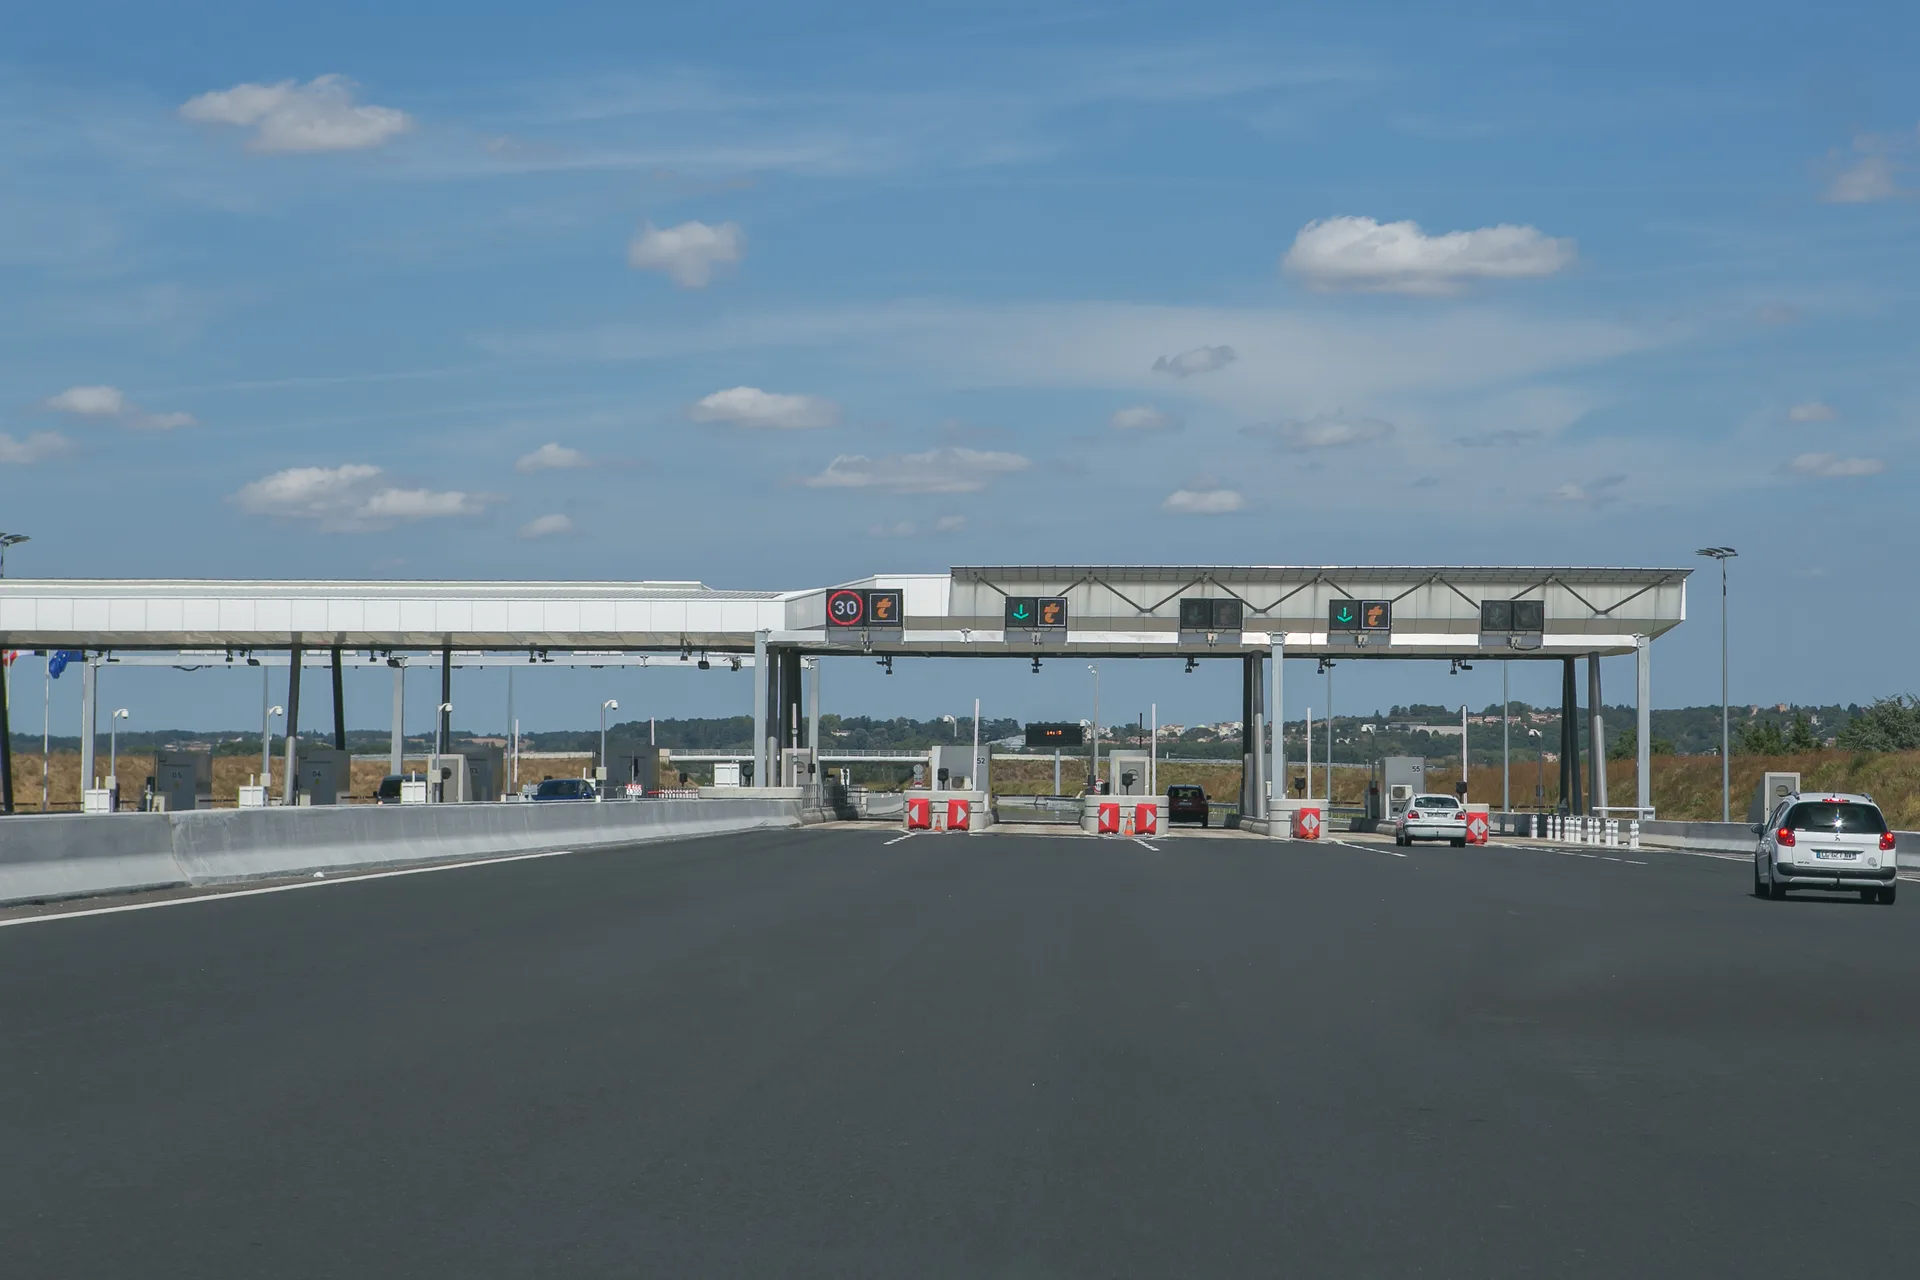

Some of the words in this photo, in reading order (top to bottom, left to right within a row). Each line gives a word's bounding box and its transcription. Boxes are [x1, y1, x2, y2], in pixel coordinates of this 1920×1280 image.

[834, 600, 857, 615] 30
[976, 757, 986, 765] 52
[1411, 765, 1421, 773] 55
